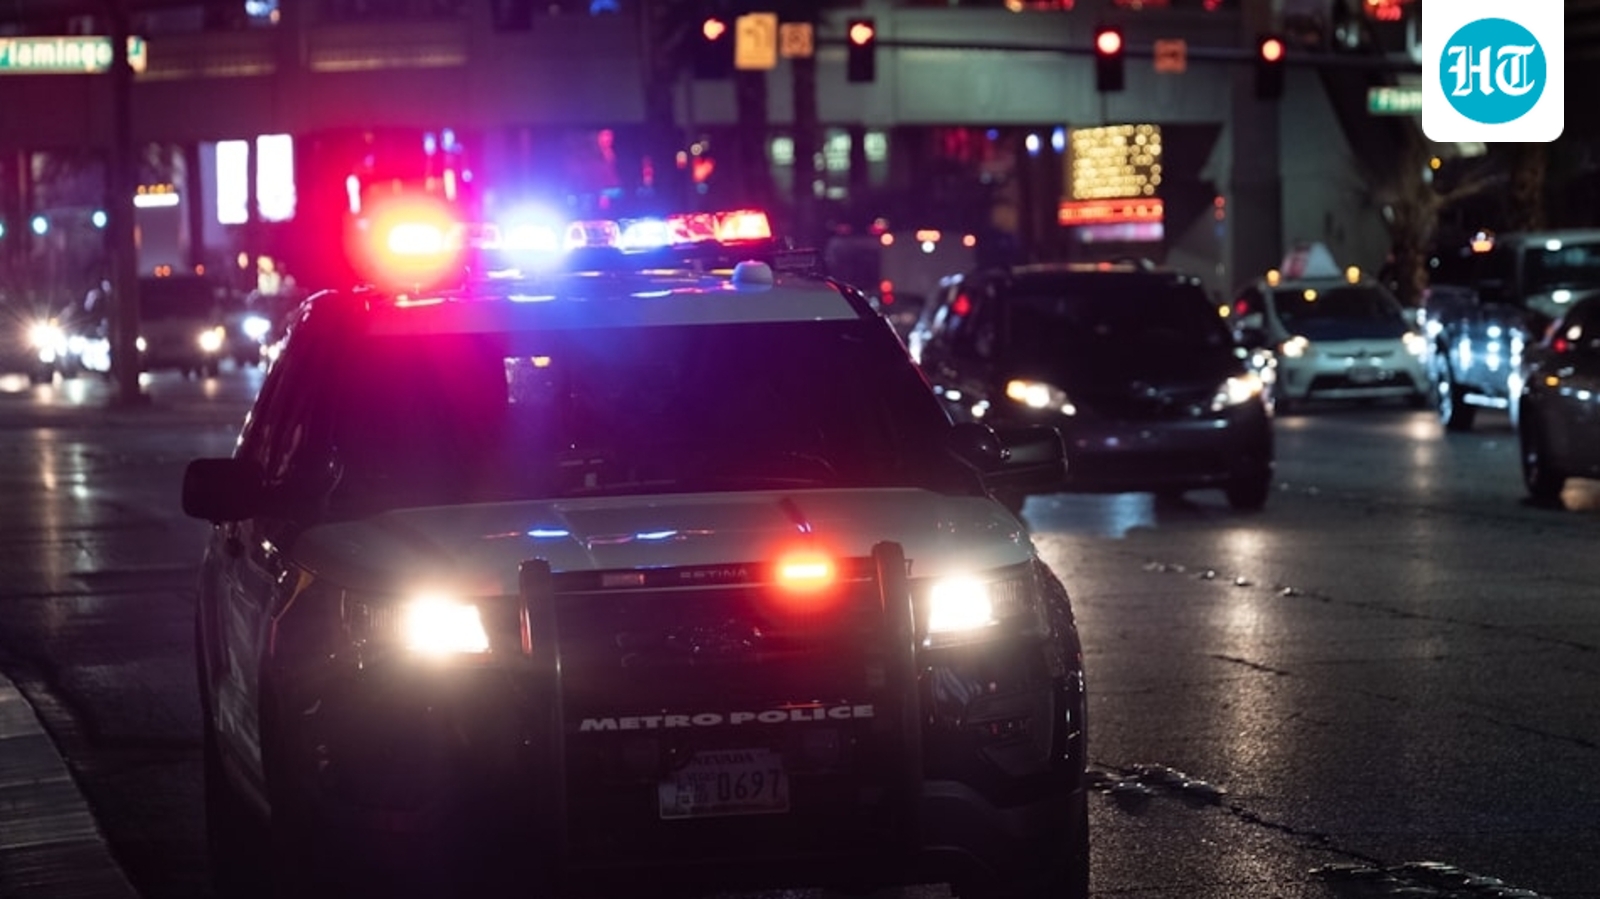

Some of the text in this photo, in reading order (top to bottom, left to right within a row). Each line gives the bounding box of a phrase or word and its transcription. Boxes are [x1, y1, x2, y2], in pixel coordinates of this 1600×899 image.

[579, 704, 874, 731] METRO POLICE
[716, 767, 779, 802] 0697
